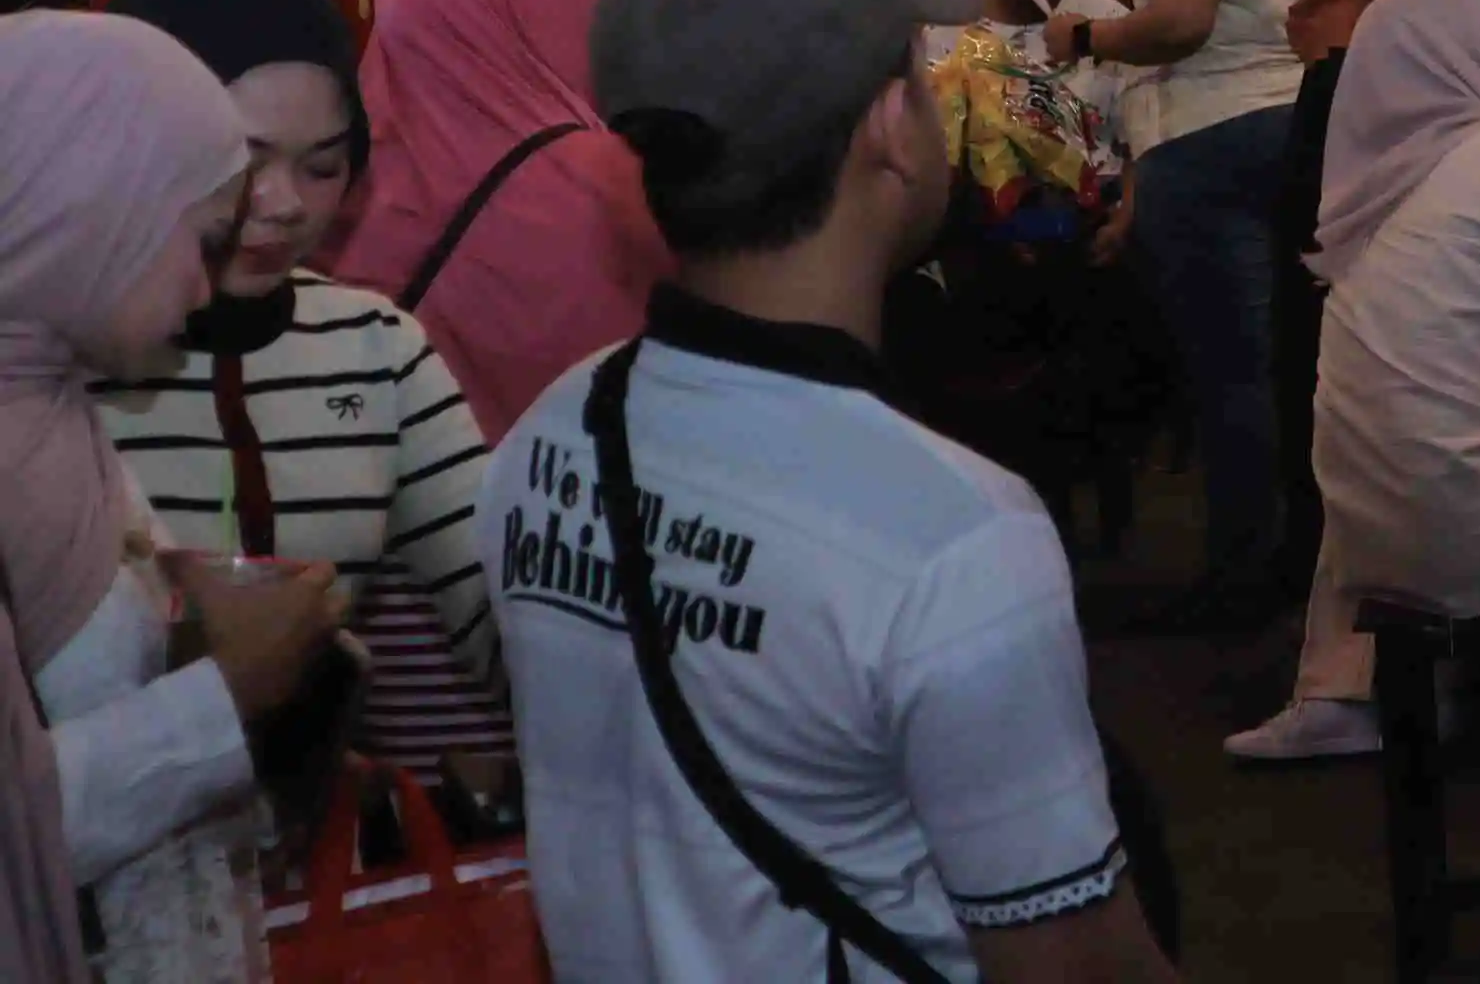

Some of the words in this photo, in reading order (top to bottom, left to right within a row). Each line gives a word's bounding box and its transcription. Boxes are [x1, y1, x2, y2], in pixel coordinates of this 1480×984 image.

[502, 504, 628, 612] Behin
[655, 581, 766, 655] you
[591, 482, 664, 547] ll
[664, 513, 755, 587] stay
